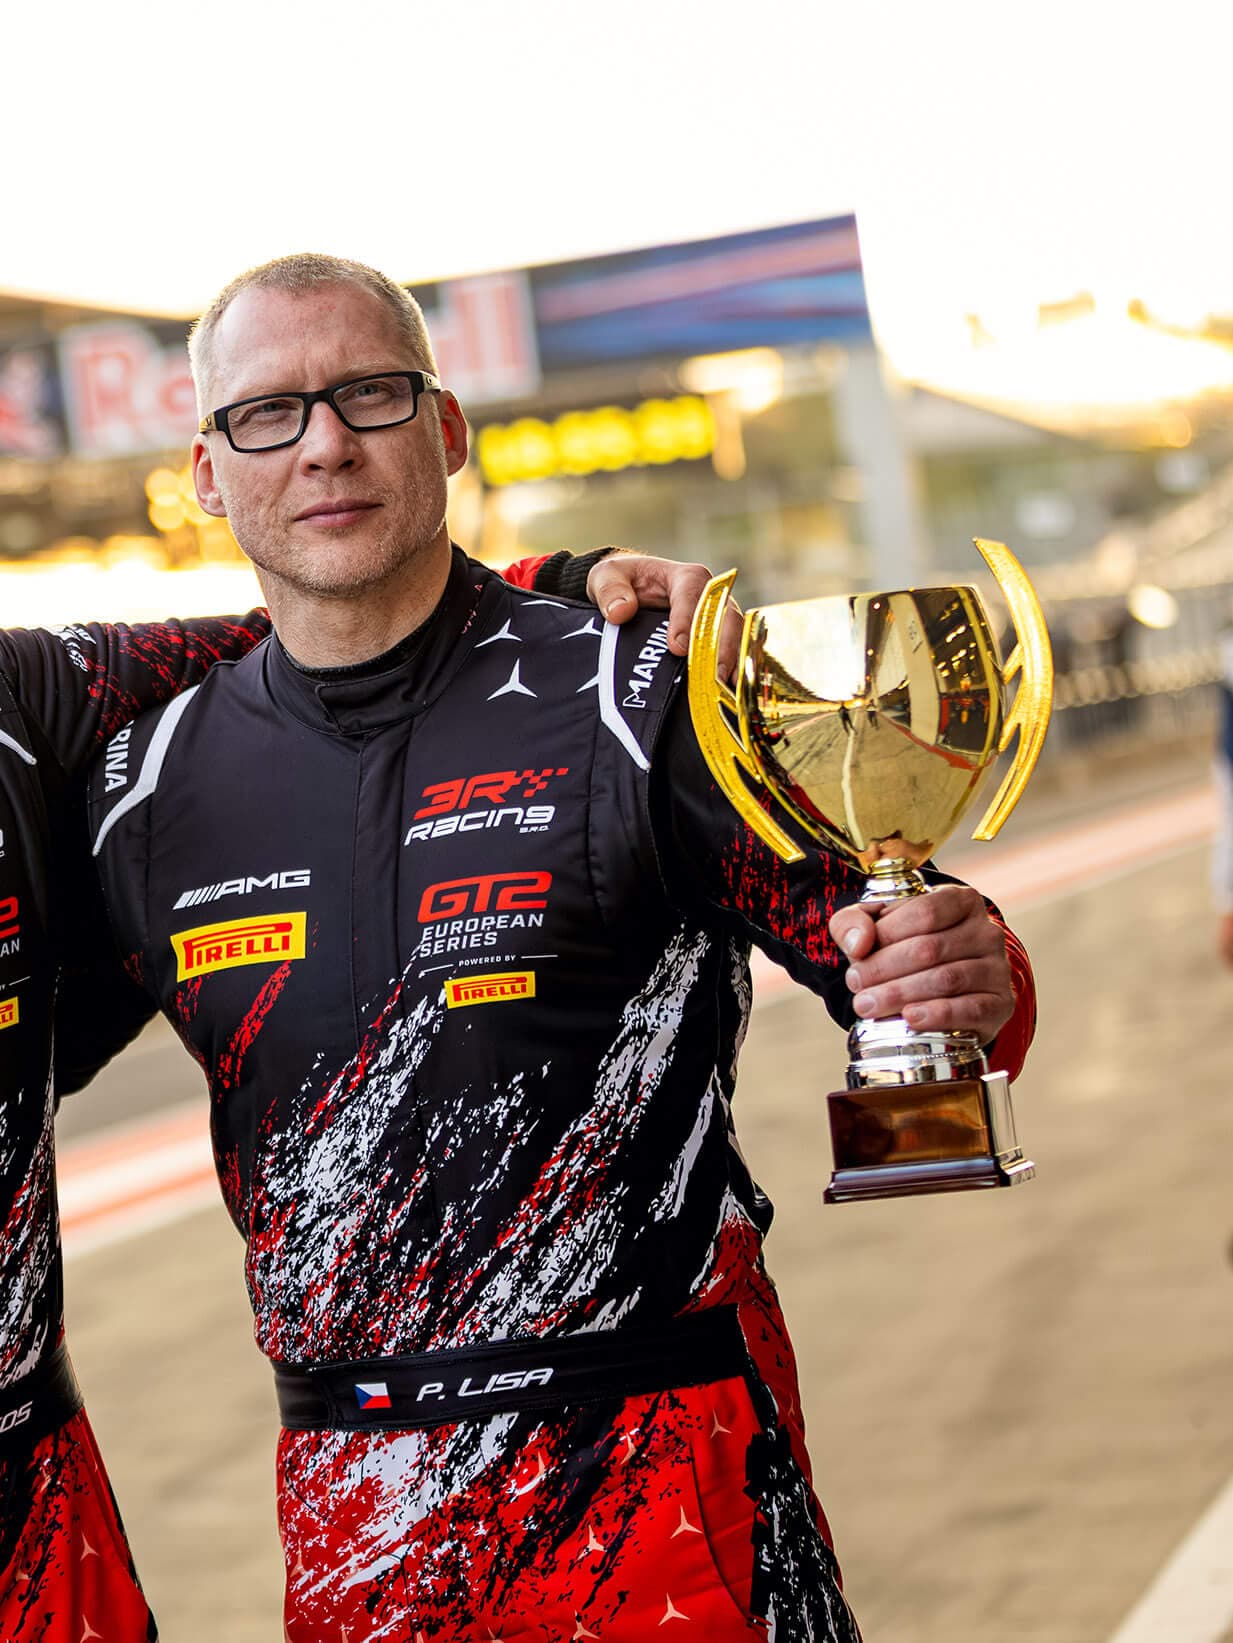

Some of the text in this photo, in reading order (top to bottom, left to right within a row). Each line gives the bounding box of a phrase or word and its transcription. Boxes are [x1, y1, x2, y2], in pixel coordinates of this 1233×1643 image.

[622, 620, 671, 709] MARIN
[105, 720, 135, 793] RINA
[417, 871, 553, 924] GT2
[419, 931, 498, 958] SERIES
[422, 913, 545, 943] EUROPEAN
[182, 921, 293, 971] PIRELLI
[458, 954, 516, 967] POWERED BY
[452, 976, 528, 1002] PIRELLI
[416, 1367, 554, 1402] P. LISA
